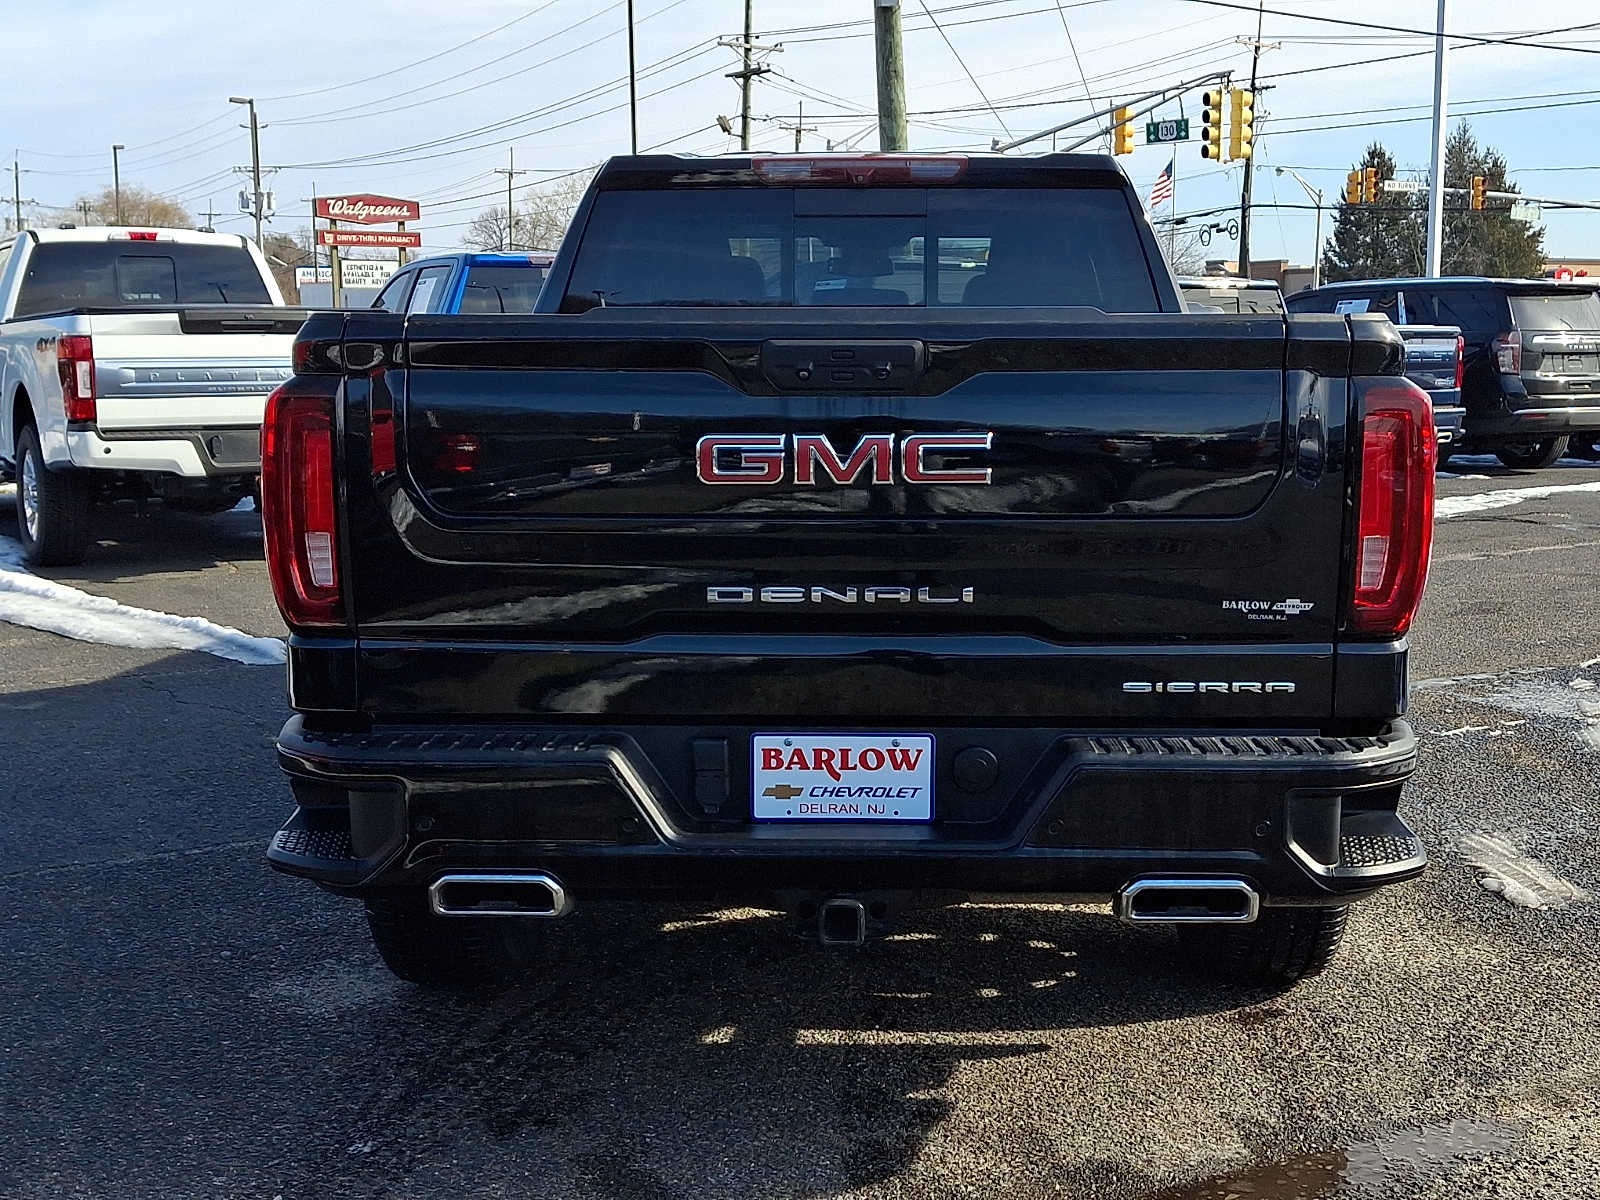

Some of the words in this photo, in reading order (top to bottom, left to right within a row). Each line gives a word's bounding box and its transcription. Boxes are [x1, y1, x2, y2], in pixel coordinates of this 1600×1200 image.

[1160, 125, 1175, 136] 130
[1398, 182, 1416, 190] TURNS
[327, 199, 411, 219] Walgreens
[336, 234, 377, 243] DRIVE-THRU
[378, 235, 415, 244] PHARMACY
[149, 370, 289, 381] PLATIN
[696, 432, 992, 485] GMC
[706, 586, 974, 604] DENALI
[1222, 600, 1271, 613] BARLOW
[1122, 682, 1296, 693] SIERRA
[760, 747, 924, 783] BARLOW
[808, 785, 924, 799] CHEVROLET
[798, 803, 863, 816] DELRAN,
[867, 803, 885, 814] NJ
